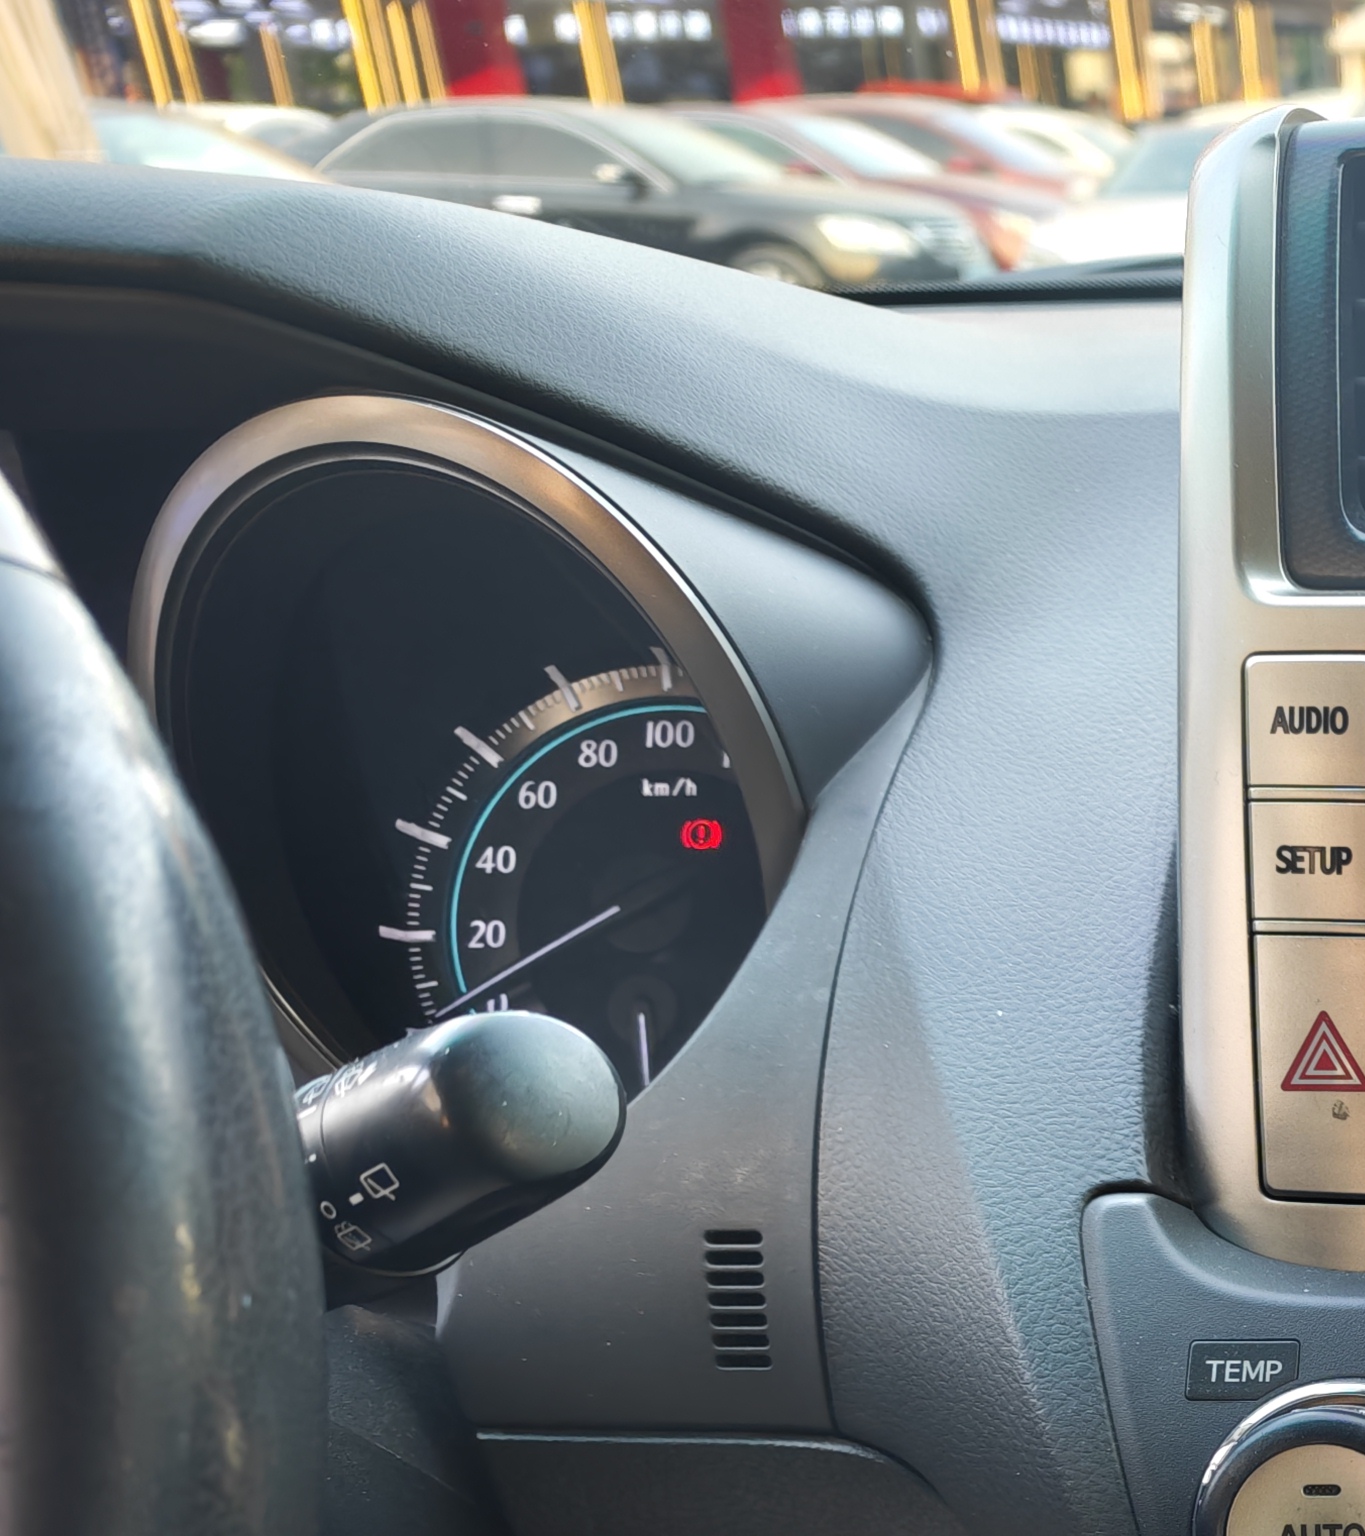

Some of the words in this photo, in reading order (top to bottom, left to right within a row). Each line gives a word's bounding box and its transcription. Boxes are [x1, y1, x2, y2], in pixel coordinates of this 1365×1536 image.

[645, 720, 695, 749] 100
[1269, 705, 1350, 736] AUDIO
[577, 739, 619, 769] 80
[518, 780, 558, 810] 60
[641, 778, 698, 798] km/h
[475, 845, 517, 874] 40
[1275, 845, 1354, 877] SETUP
[467, 919, 507, 949] 20
[1205, 1358, 1283, 1383] TEMP
